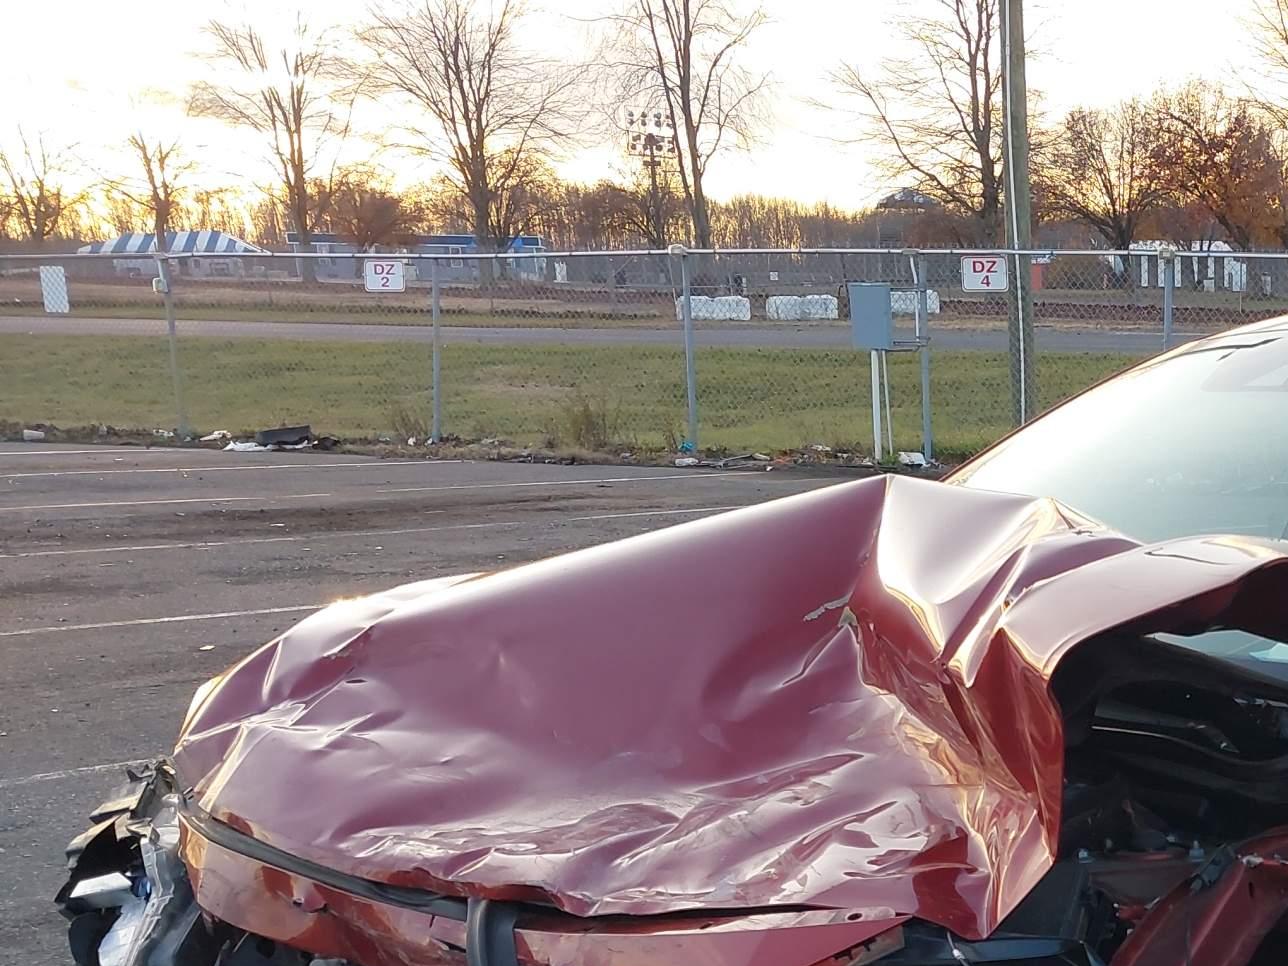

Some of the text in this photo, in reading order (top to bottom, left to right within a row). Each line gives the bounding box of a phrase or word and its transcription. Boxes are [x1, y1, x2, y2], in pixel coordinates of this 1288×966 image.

[374, 263, 396, 275] DZ
[973, 260, 998, 273] DZ
[380, 276, 390, 288] 2
[980, 275, 991, 287] 4
